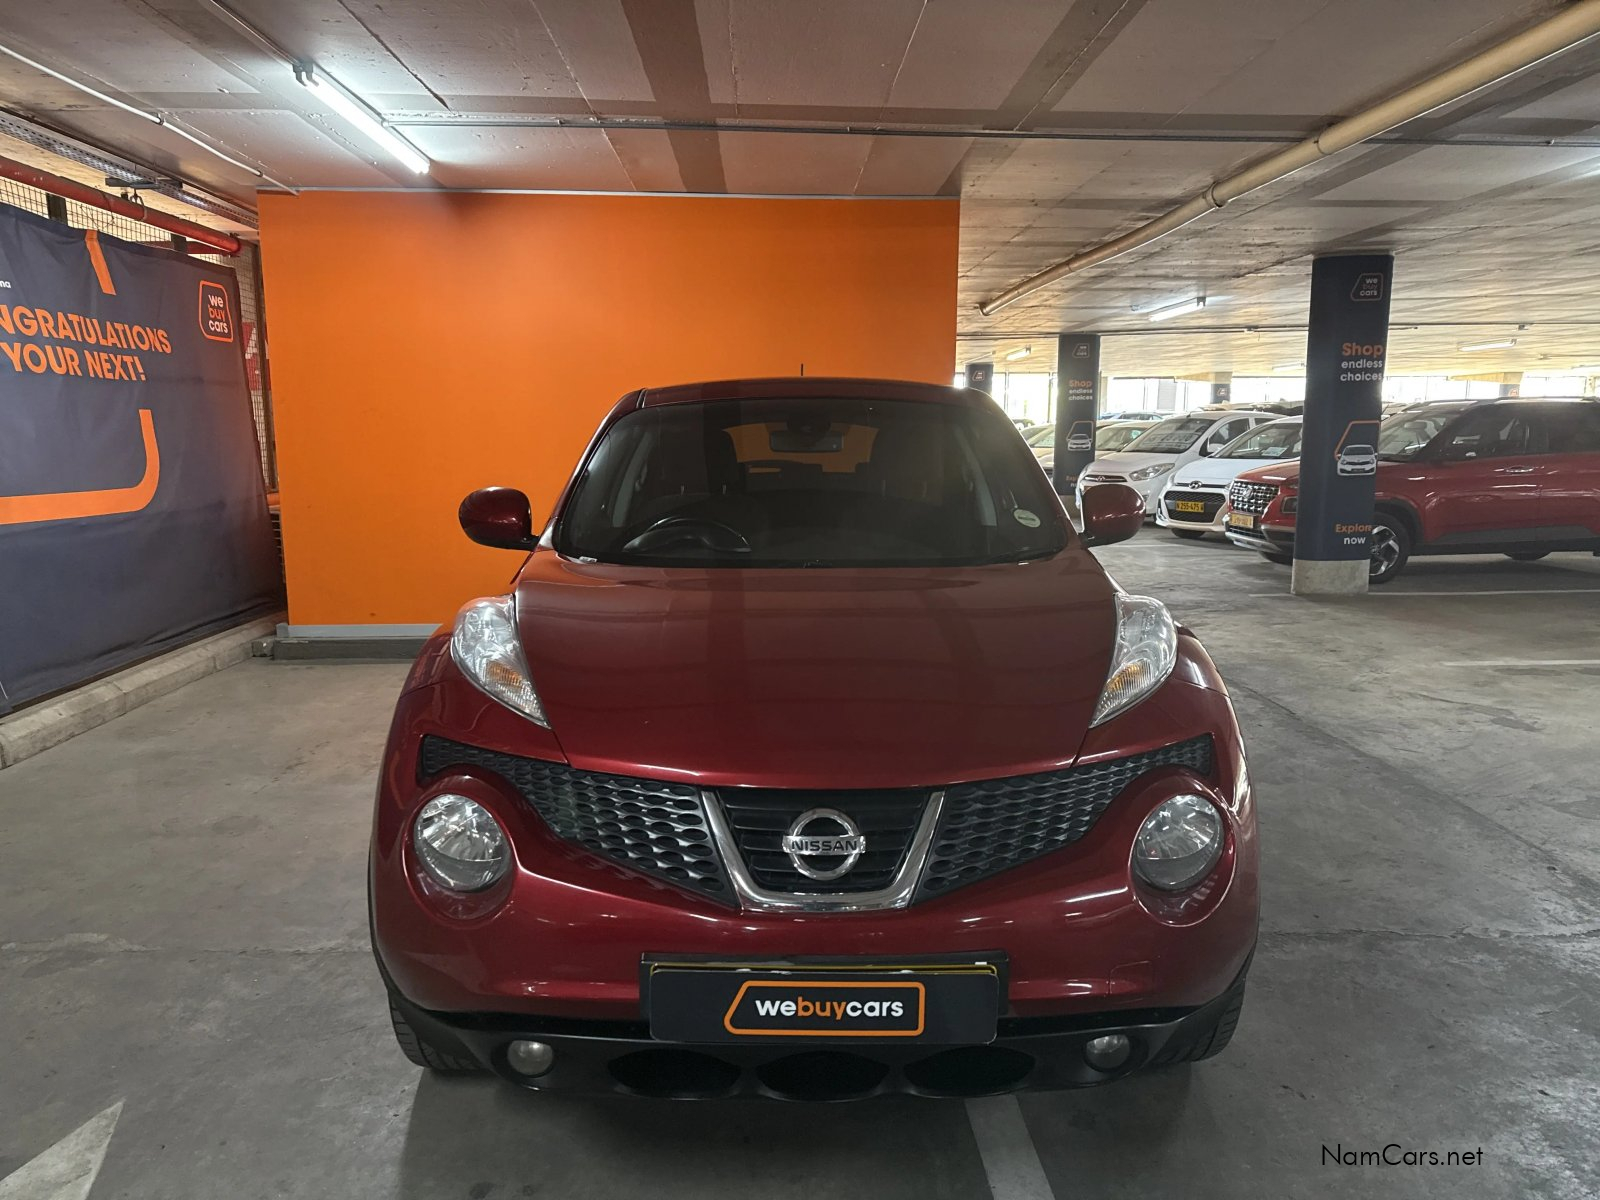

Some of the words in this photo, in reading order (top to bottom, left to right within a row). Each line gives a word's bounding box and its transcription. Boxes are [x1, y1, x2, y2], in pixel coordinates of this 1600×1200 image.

[208, 294, 224, 308] we
[208, 304, 226, 322] buy
[208, 320, 229, 334] cars
[1342, 342, 1384, 358] Shop
[0, 342, 83, 377] YOUR
[84, 349, 146, 381] NEXT!
[1341, 359, 1383, 369] endless
[1340, 371, 1383, 381] choices
[1069, 379, 1093, 389] Shop
[1343, 536, 1366, 545] now
[791, 840, 857, 852] NISSAN
[755, 996, 904, 1021] webuycars
